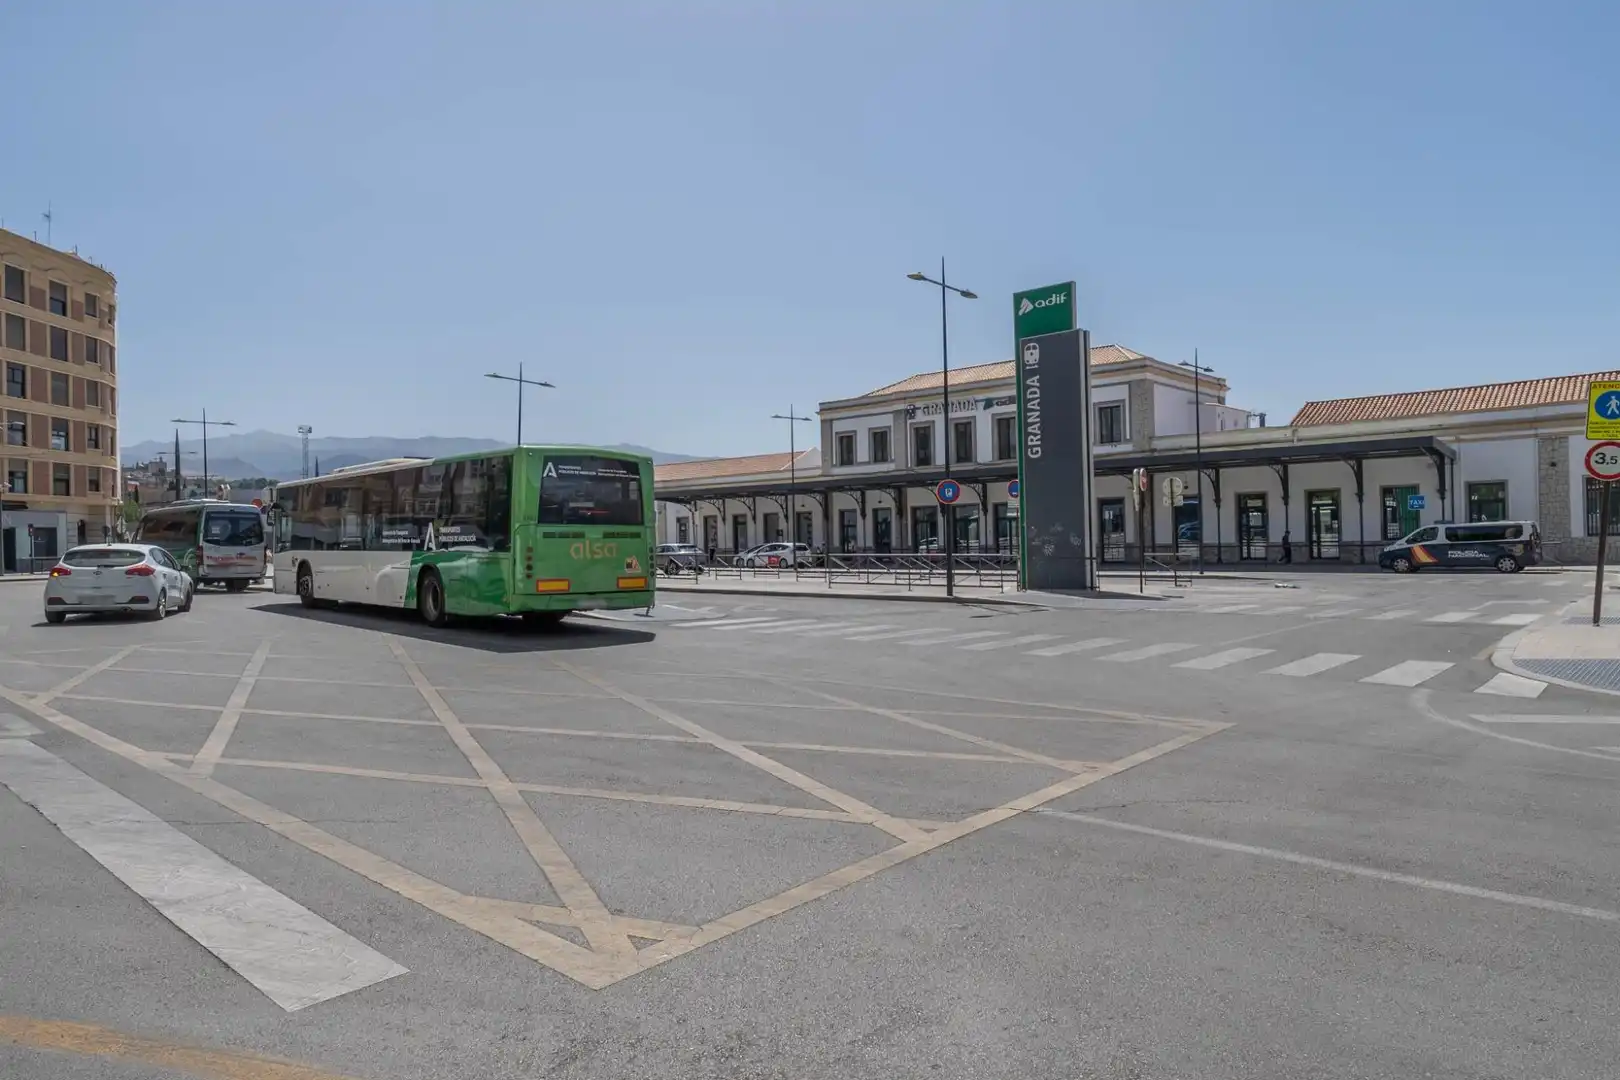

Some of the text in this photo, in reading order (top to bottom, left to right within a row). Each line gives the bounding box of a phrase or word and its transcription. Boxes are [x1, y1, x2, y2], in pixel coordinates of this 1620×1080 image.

[1034, 292, 1068, 309] adif
[1026, 375, 1042, 459] GRANADA
[1594, 452, 1618, 465] 3,5
[569, 540, 618, 559] alsa
